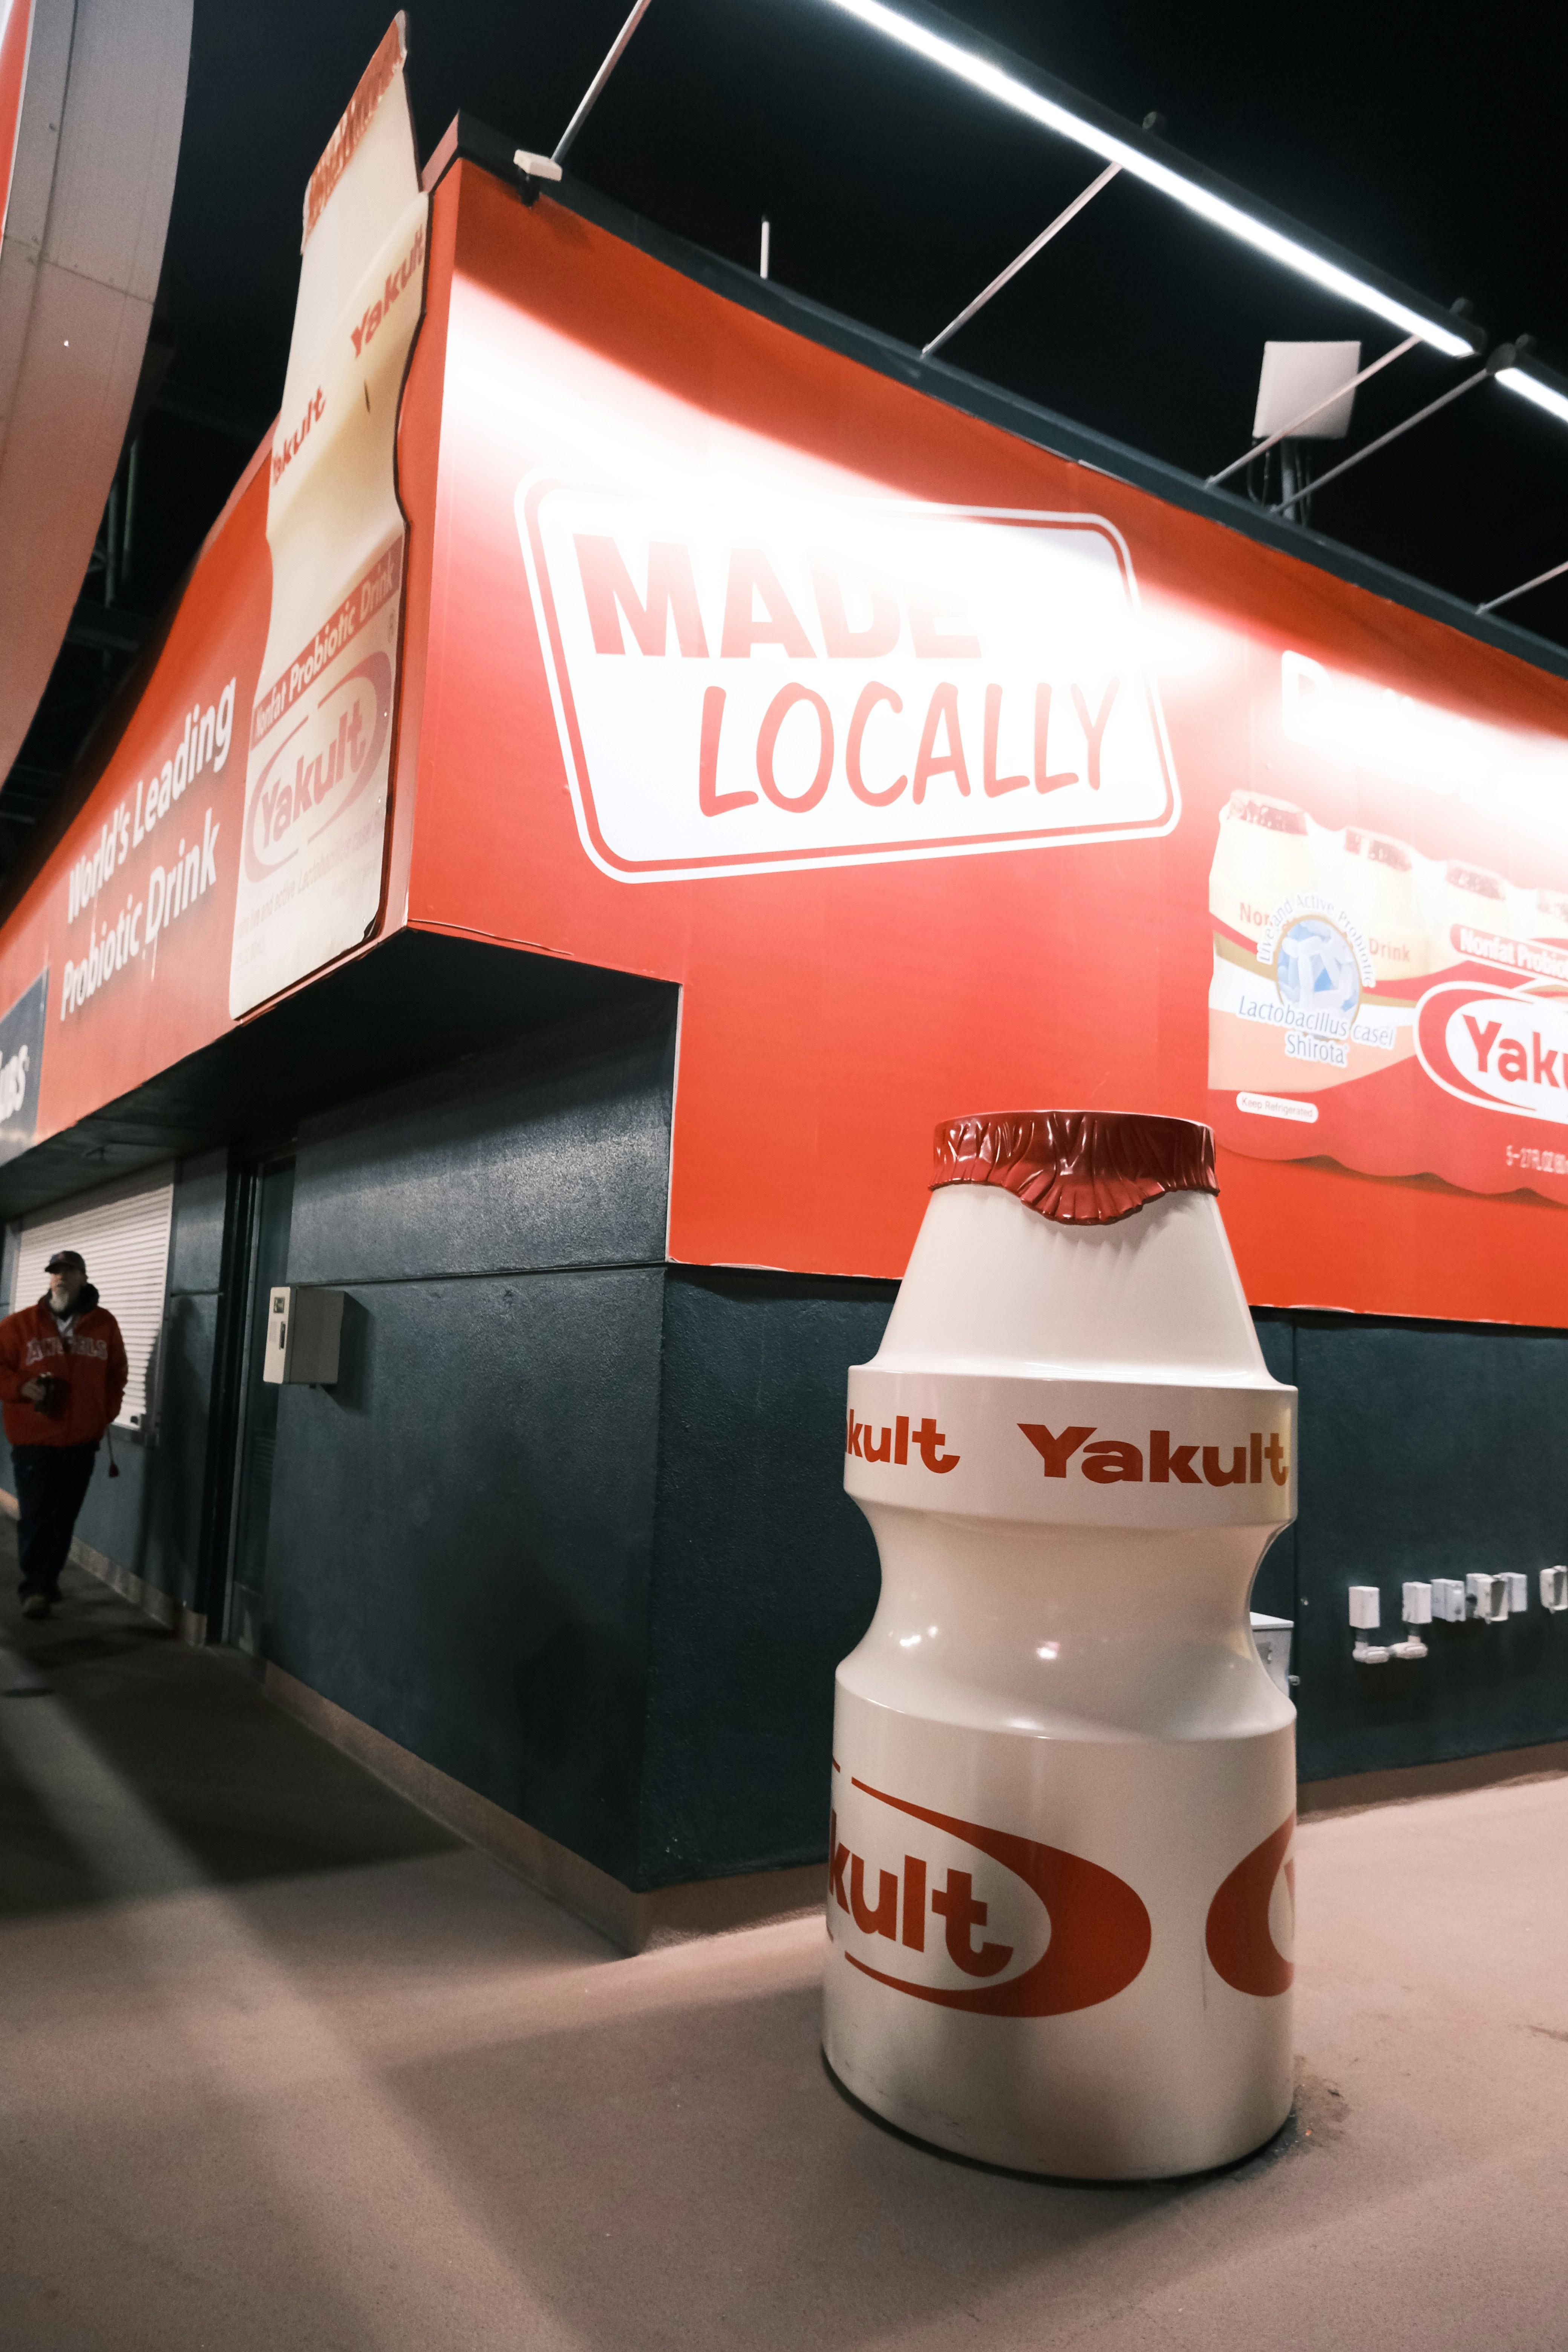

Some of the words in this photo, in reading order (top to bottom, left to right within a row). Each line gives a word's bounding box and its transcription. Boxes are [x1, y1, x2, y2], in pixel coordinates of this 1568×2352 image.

[289, 601, 356, 702] Probiotic
[360, 548, 394, 622] Drink
[573, 533, 982, 659] MADE
[262, 697, 367, 852] Yakult
[699, 677, 1120, 817] LOCALLY
[68, 802, 130, 924] World's
[133, 677, 237, 848] Leading
[60, 894, 143, 1021] Probiotic
[145, 808, 220, 944] Drink
[1260, 927, 1275, 962] Live
[1274, 897, 1293, 926] and
[1297, 894, 1334, 916] Active
[1338, 910, 1374, 986] Probiotic
[1369, 937, 1410, 962] Drink
[1460, 927, 1514, 965] Nonfat
[1517, 942, 1568, 980] Probio
[1239, 995, 1347, 1037] Lactobacillus
[1353, 1024, 1394, 1047] casei
[1288, 1034, 1344, 1064] Shirota
[1242, 1097, 1262, 1110] Keep
[1265, 1100, 1313, 1117] Refrigerated
[846, 1409, 960, 1474] kult
[1017, 1423, 1289, 1487] Yakult
